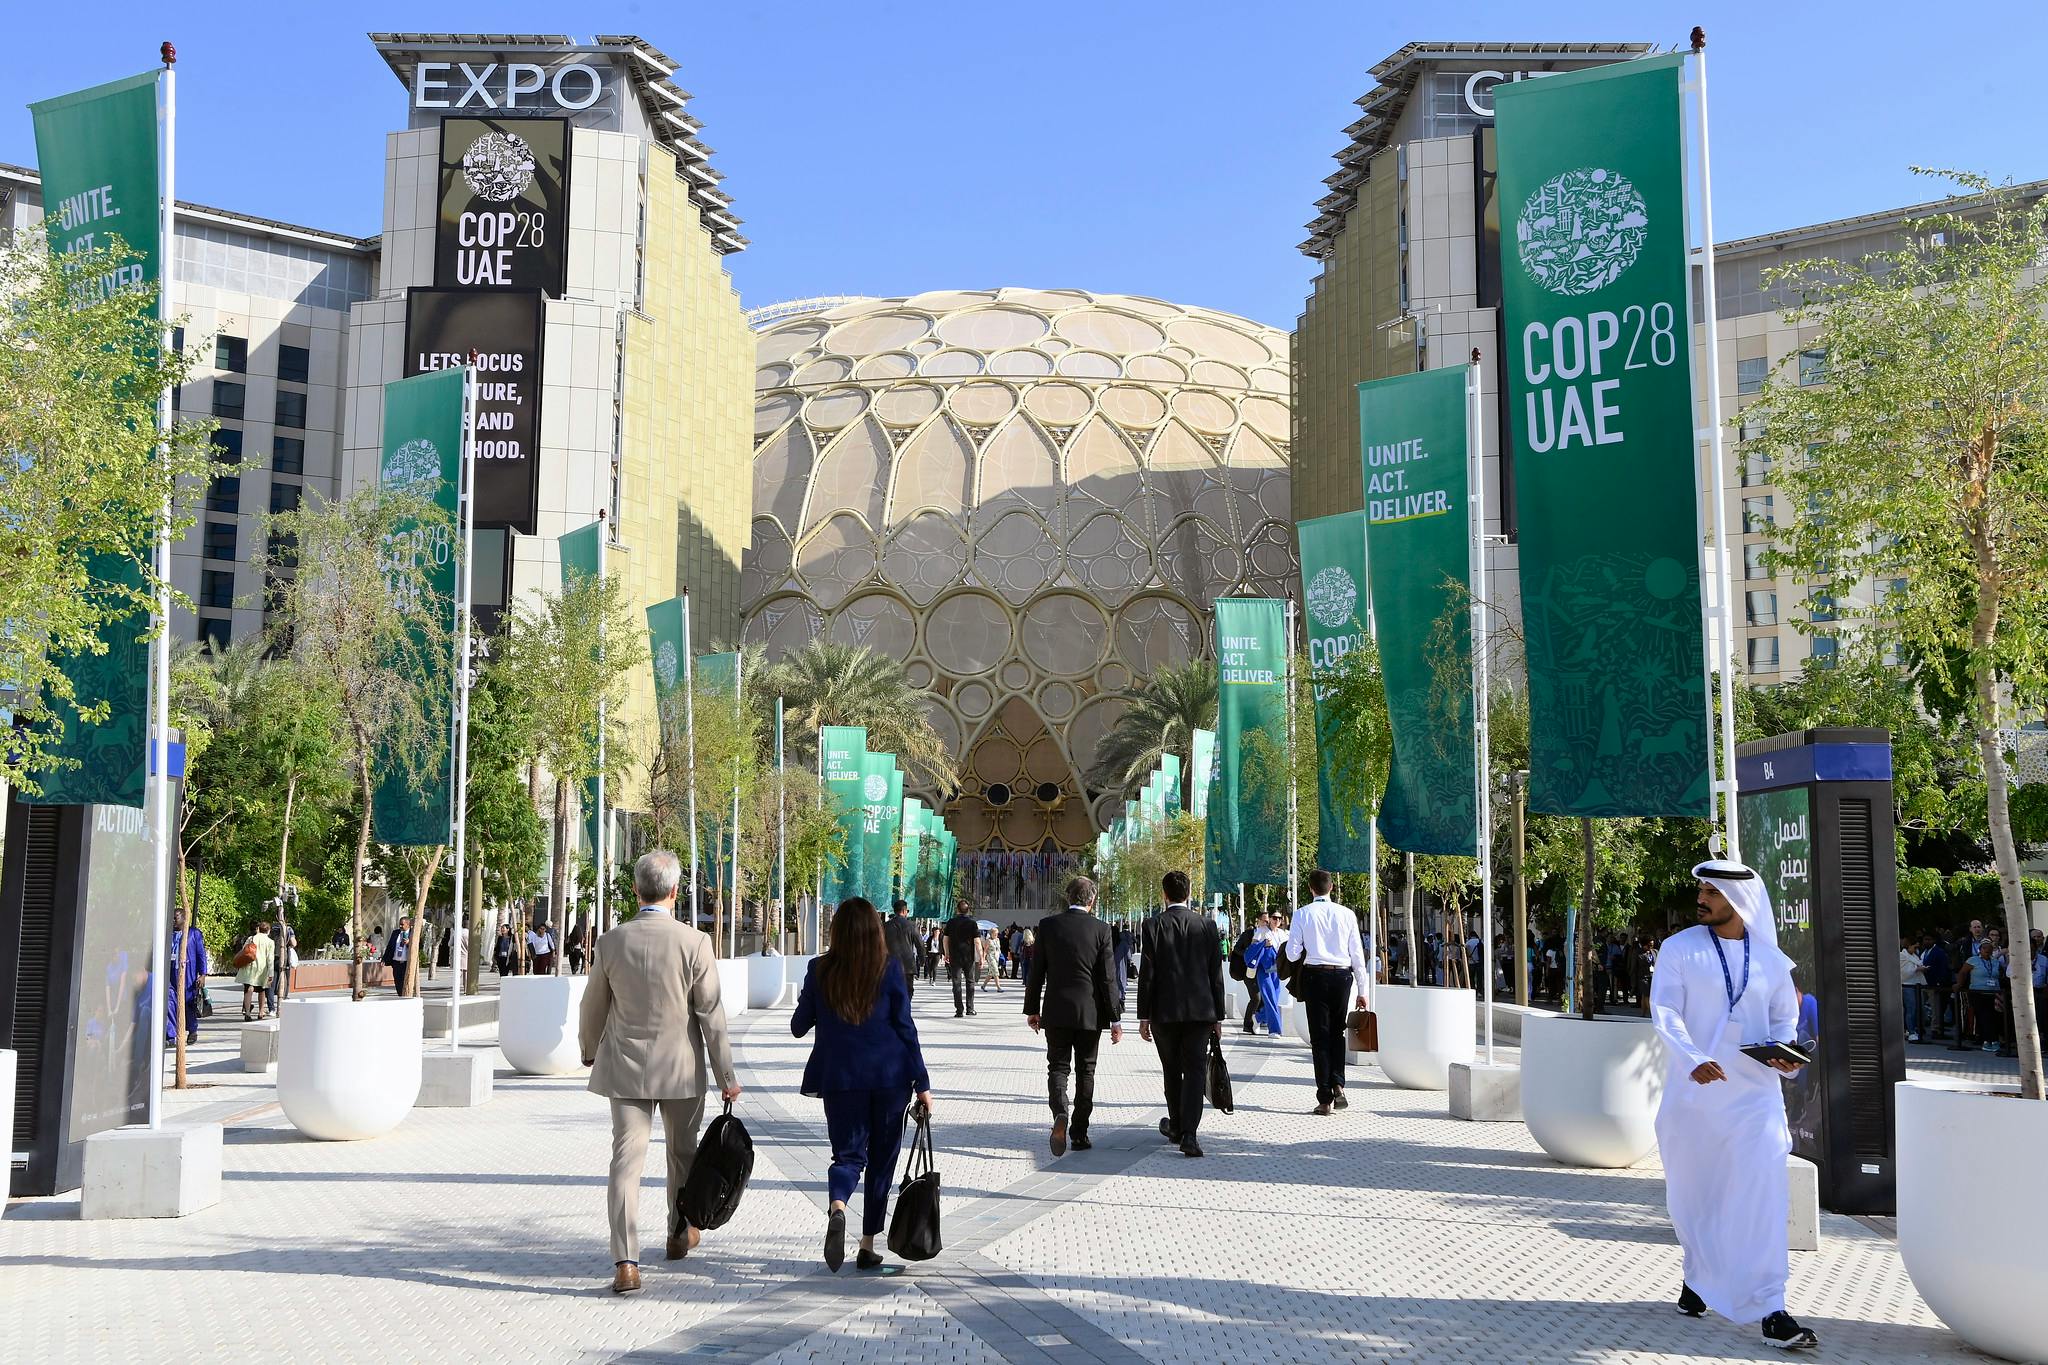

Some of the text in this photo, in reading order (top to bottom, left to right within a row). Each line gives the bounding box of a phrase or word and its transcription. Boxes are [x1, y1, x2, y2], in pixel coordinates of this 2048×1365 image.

[415, 62, 602, 110] EXPO
[59, 185, 120, 231] UNITE.
[458, 211, 546, 248] COP28
[456, 249, 513, 285] UAE
[1522, 302, 1677, 386] COP28
[419, 352, 462, 372] LETS
[476, 411, 515, 431] AND
[1526, 378, 1625, 454] UAE
[1368, 437, 1429, 467] UNITE.
[1368, 469, 1409, 495] ACT.
[1369, 489, 1453, 522] DELIVER.
[1221, 636, 1261, 651] UNITE.
[1221, 652, 1248, 667] ACT.
[1222, 668, 1277, 684] DELIVER.
[827, 751, 851, 759] UNITE.
[827, 761, 843, 769] ACT.
[827, 771, 860, 780] DELIVER.
[1764, 762, 1774, 780] B4
[97, 804, 144, 834] ACTION
[1774, 815, 1806, 850] العمل
[1780, 853, 1808, 890] يصنع
